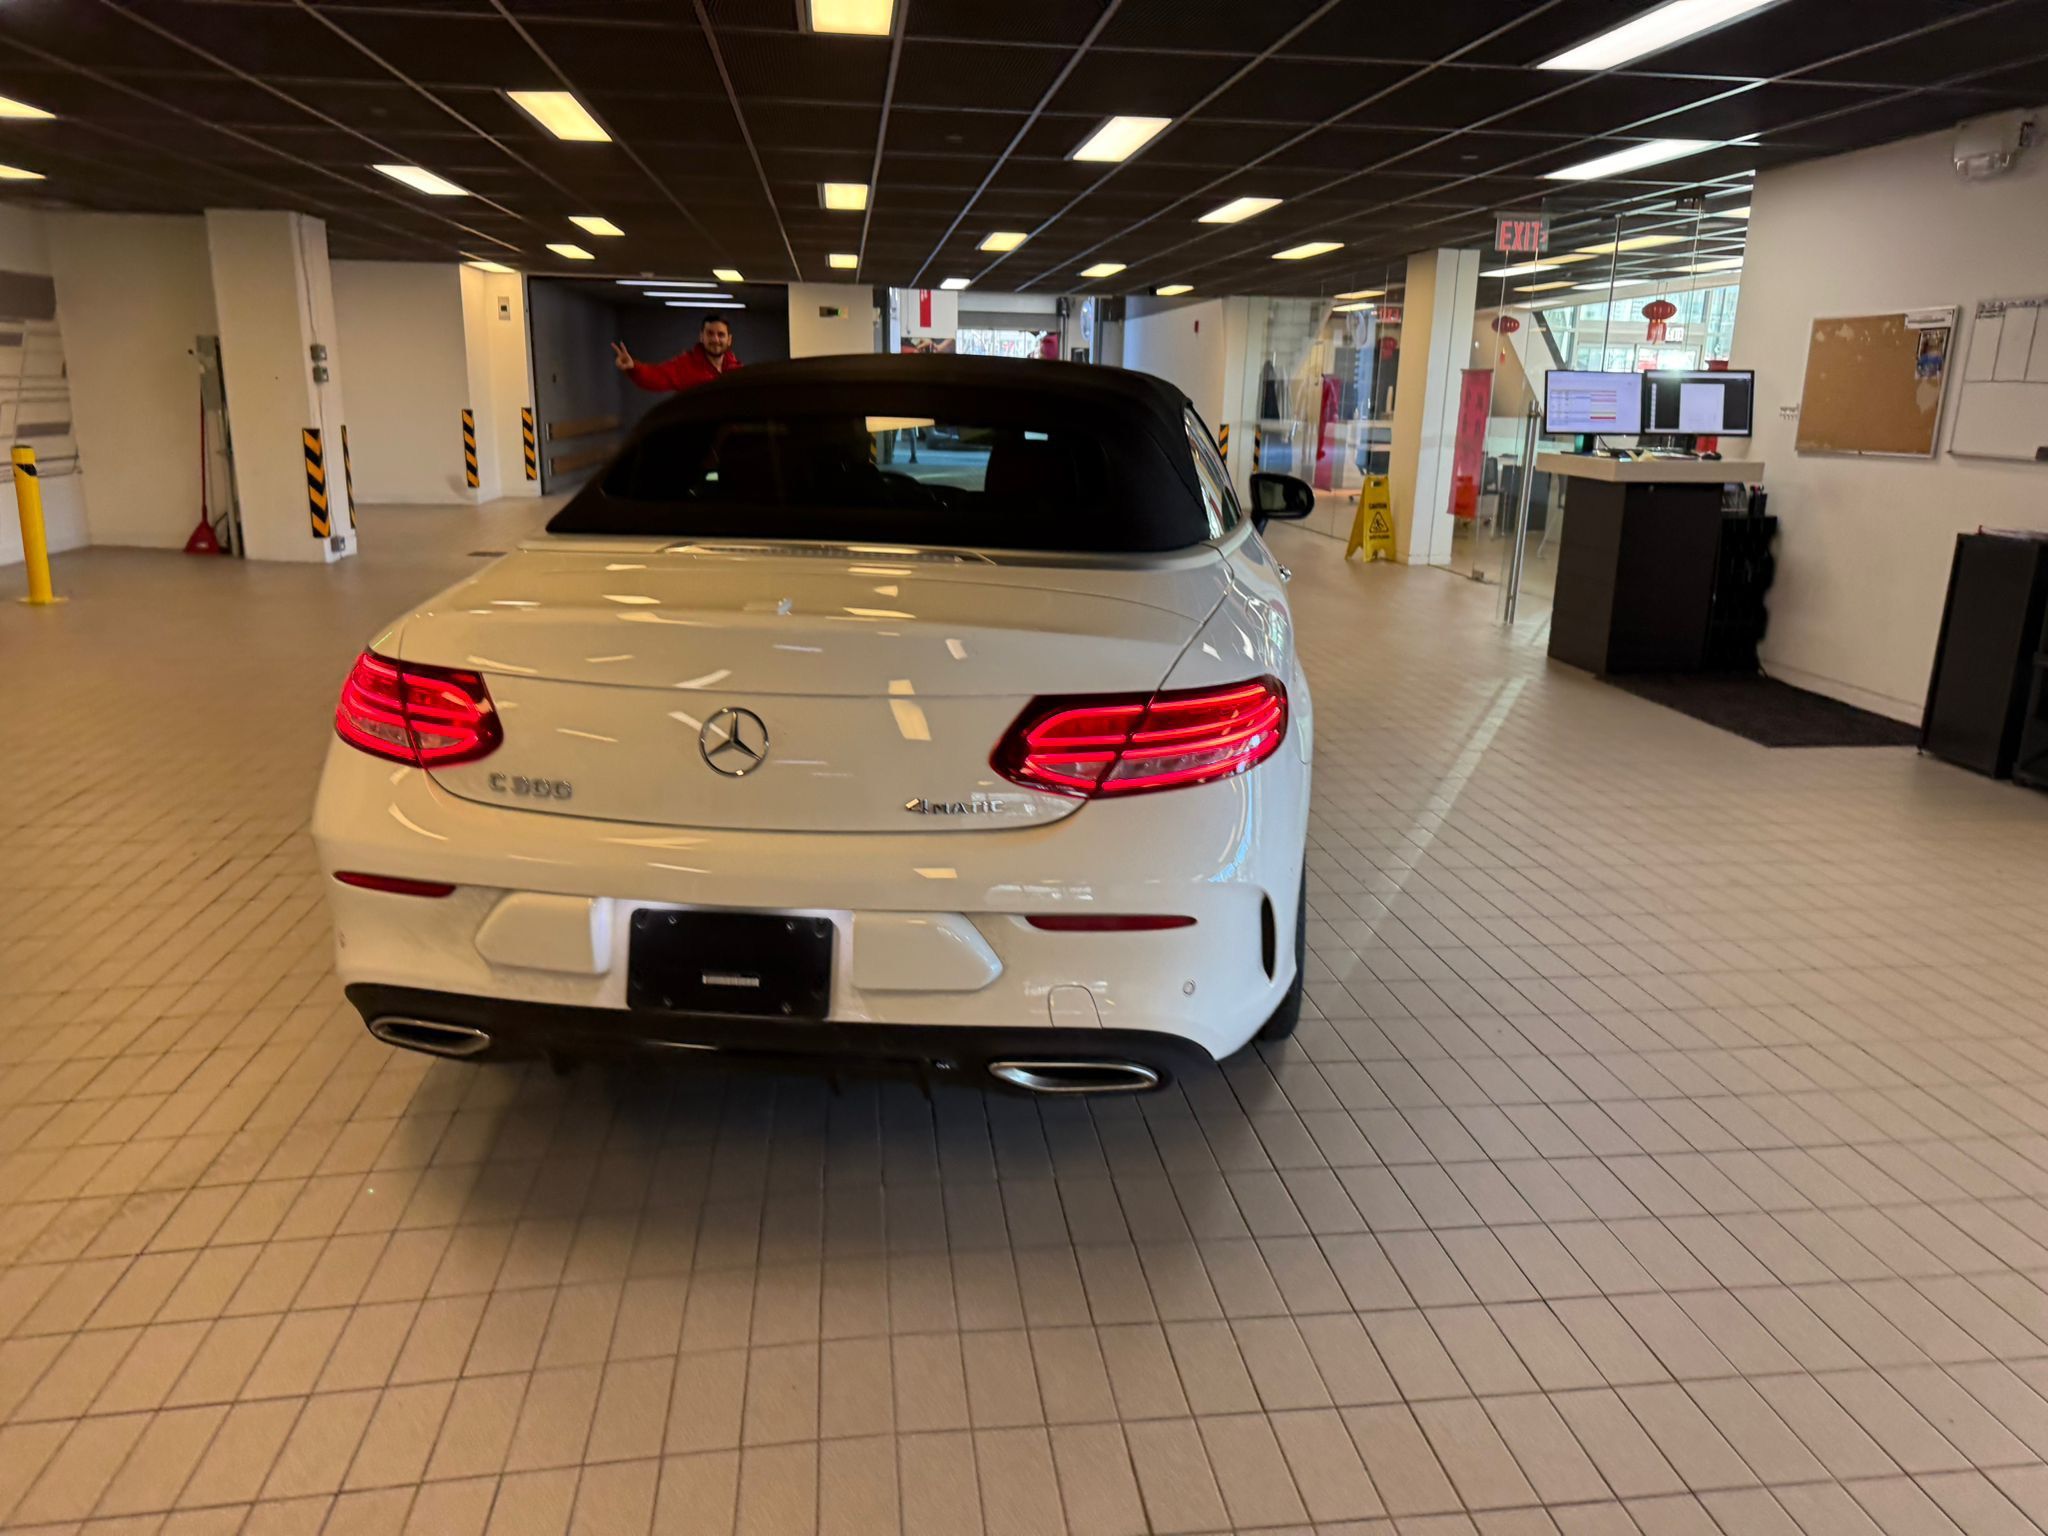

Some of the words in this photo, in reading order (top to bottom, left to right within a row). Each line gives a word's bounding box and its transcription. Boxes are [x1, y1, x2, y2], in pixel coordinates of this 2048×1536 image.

[1500, 221, 1542, 250] EXIT
[489, 772, 506, 792] C
[905, 798, 1004, 815] 4MATIC
